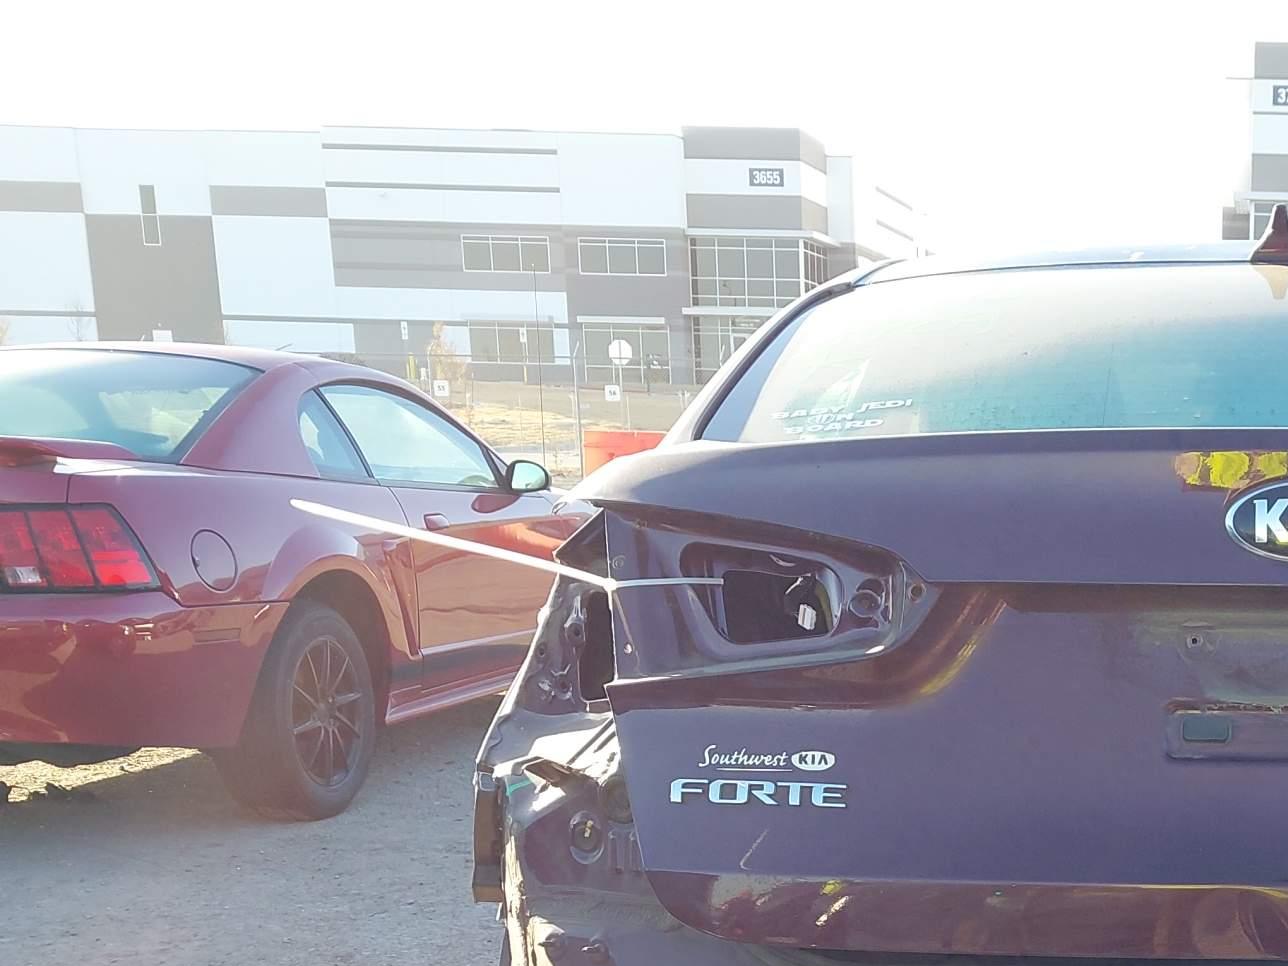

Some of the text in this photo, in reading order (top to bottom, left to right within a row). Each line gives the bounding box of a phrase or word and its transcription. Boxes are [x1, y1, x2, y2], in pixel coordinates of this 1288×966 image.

[753, 170, 780, 184] 3655
[772, 399, 913, 419] BABY JEDI
[784, 419, 884, 434] BOARD
[698, 744, 829, 768] Southwest KIA
[670, 778, 847, 808] FORTE
